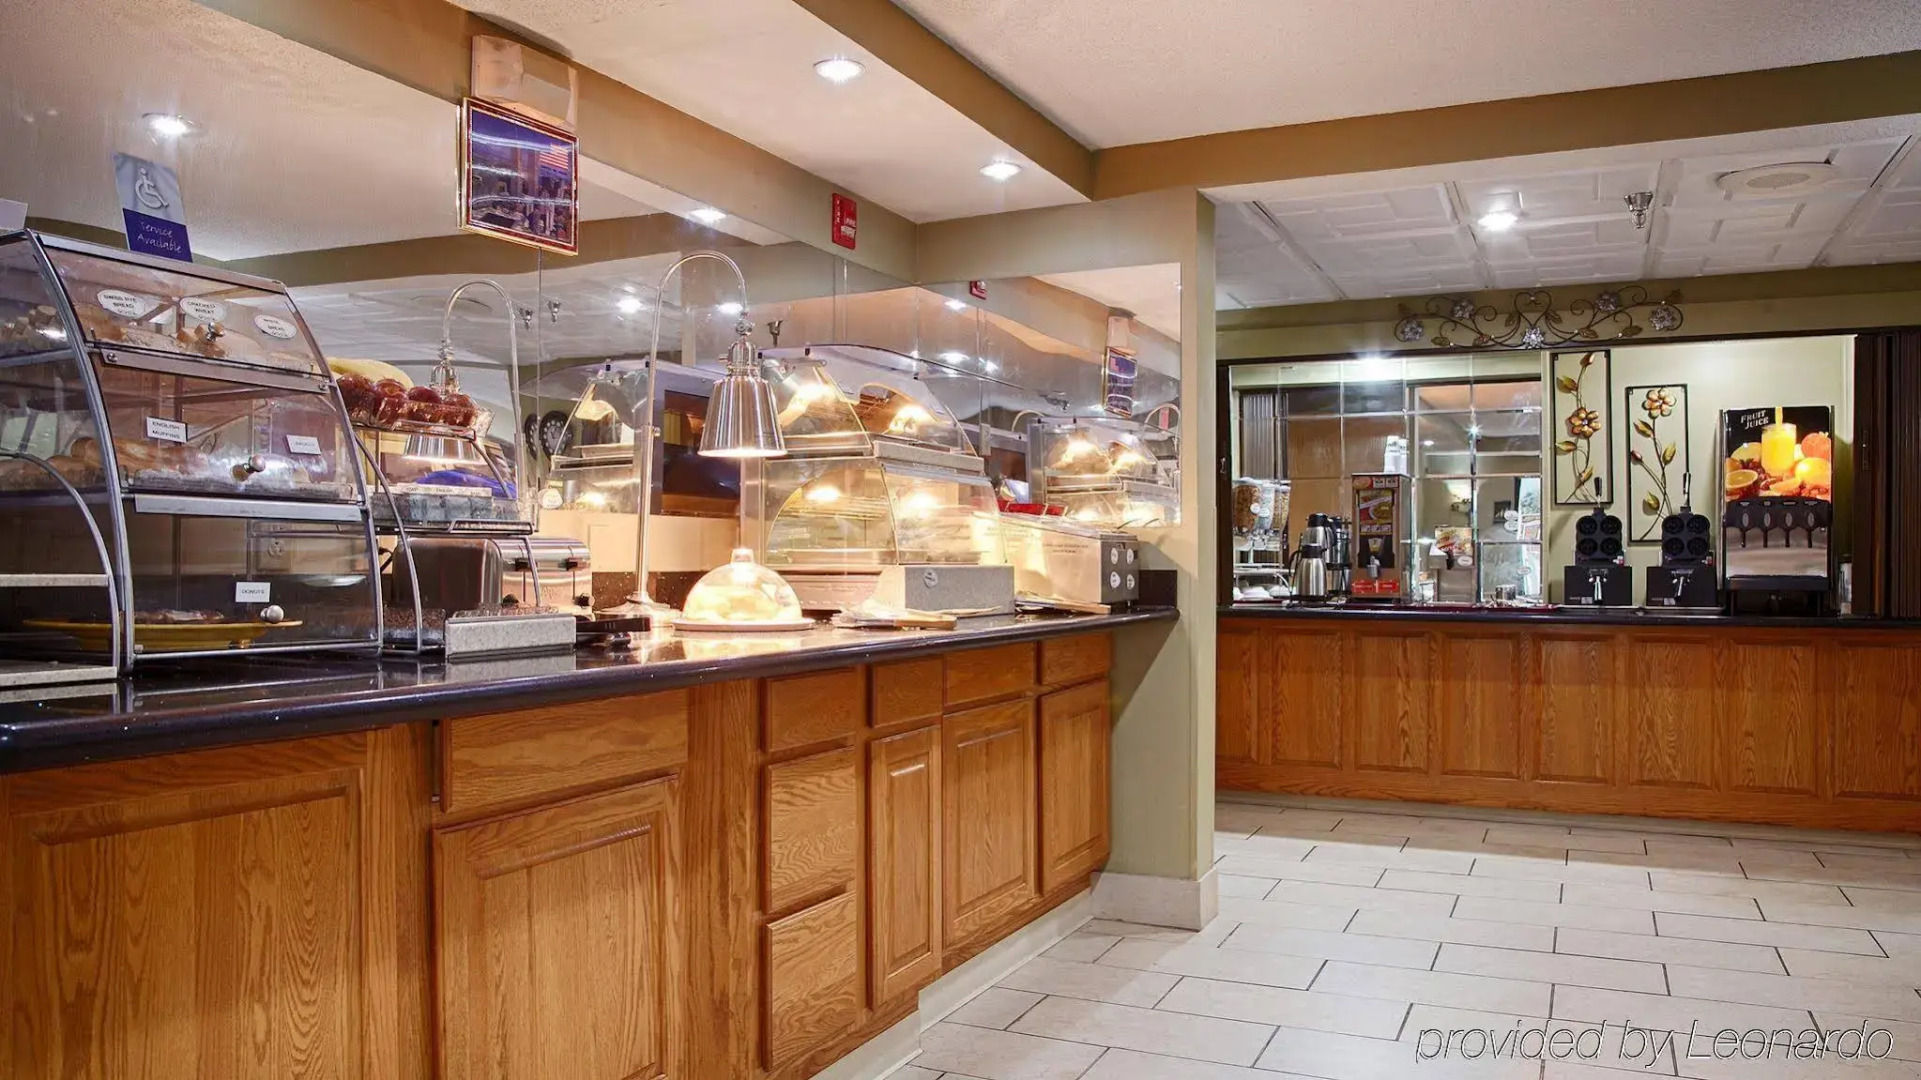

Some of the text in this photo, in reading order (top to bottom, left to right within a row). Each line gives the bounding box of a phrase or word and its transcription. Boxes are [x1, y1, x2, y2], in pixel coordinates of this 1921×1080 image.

[139, 221, 173, 238] Service
[137, 233, 182, 253] Available
[1740, 410, 1767, 424] FRUIT
[1744, 416, 1769, 430] JUICE
[152, 421, 180, 430] ENGLISH
[152, 430, 180, 439] MUFFINS
